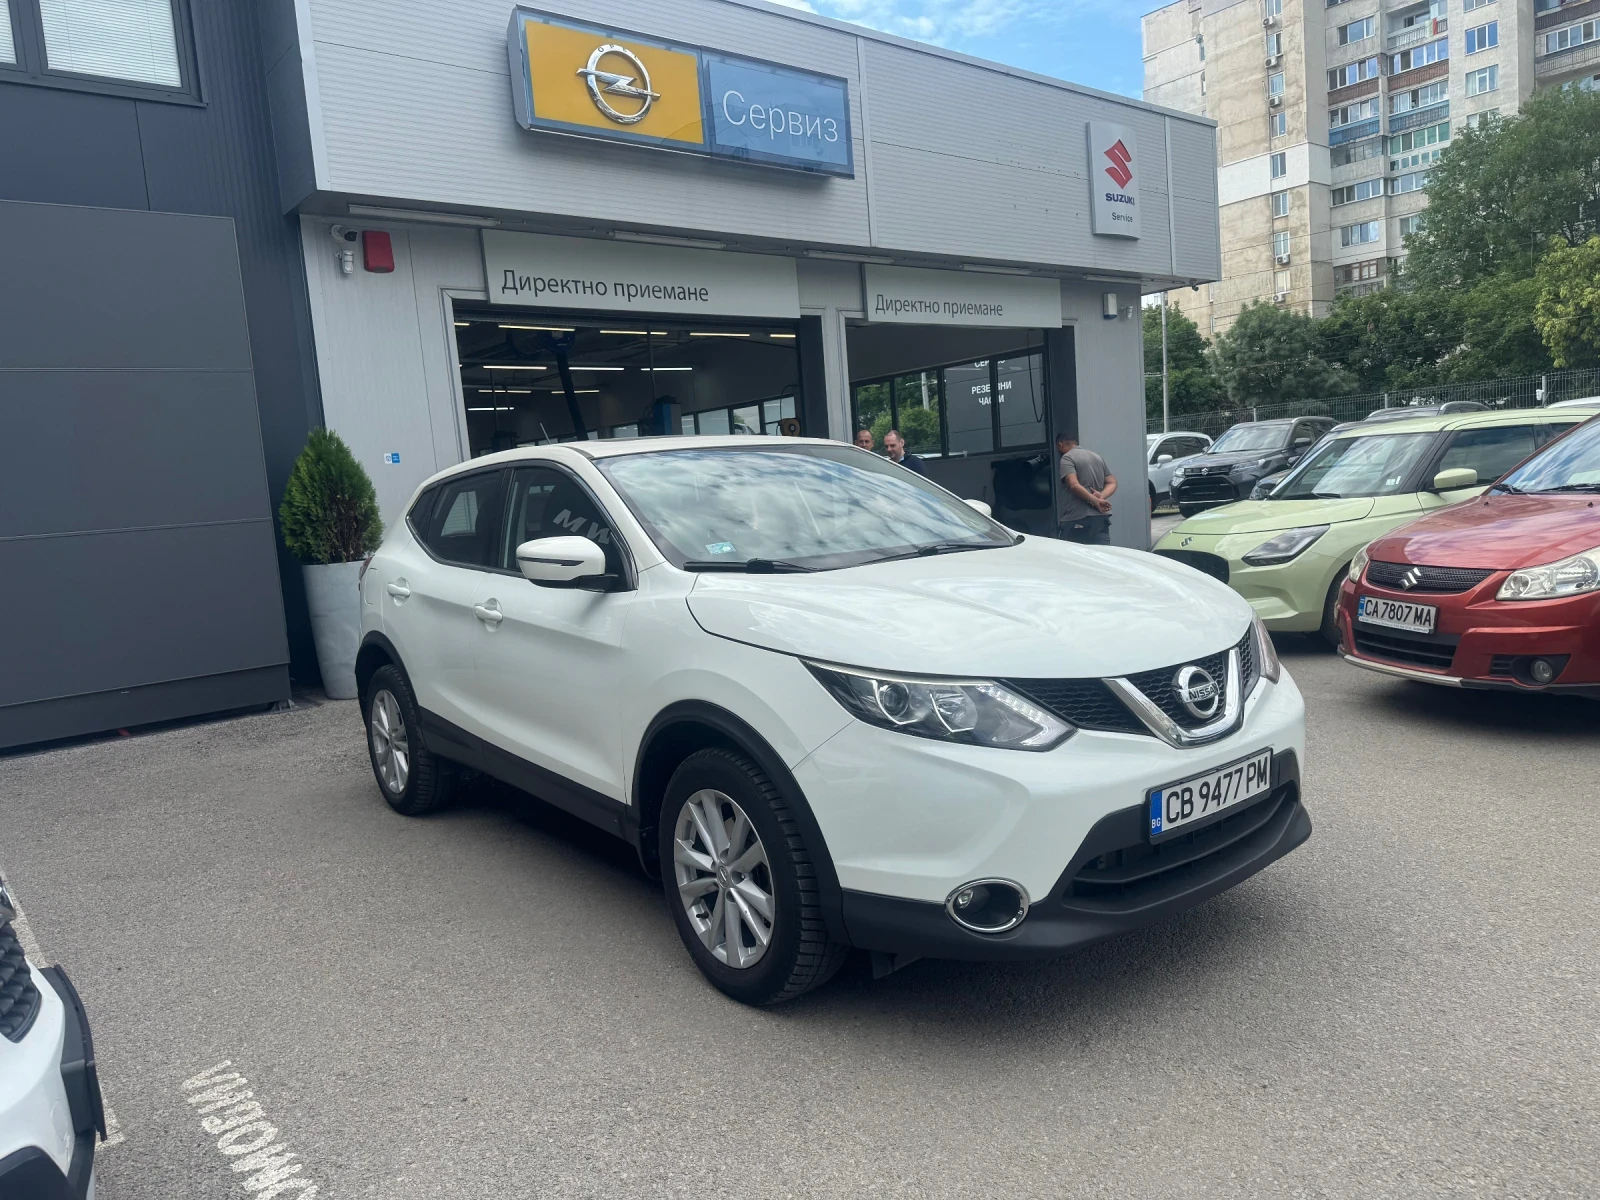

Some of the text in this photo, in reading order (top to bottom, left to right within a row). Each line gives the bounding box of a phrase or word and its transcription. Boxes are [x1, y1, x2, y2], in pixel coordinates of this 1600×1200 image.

[722, 90, 839, 142] Сервиз
[1105, 193, 1135, 206] SUZUKI
[1112, 212, 1133, 223] Service
[501, 269, 709, 303] Директно приемане
[875, 294, 1003, 318] Директно приемане
[1365, 600, 1379, 618] CA
[1381, 602, 1413, 622] 7807
[1413, 606, 1432, 627] MA
[1166, 756, 1268, 824] CB 9477 PM
[1152, 818, 1162, 829] BG
